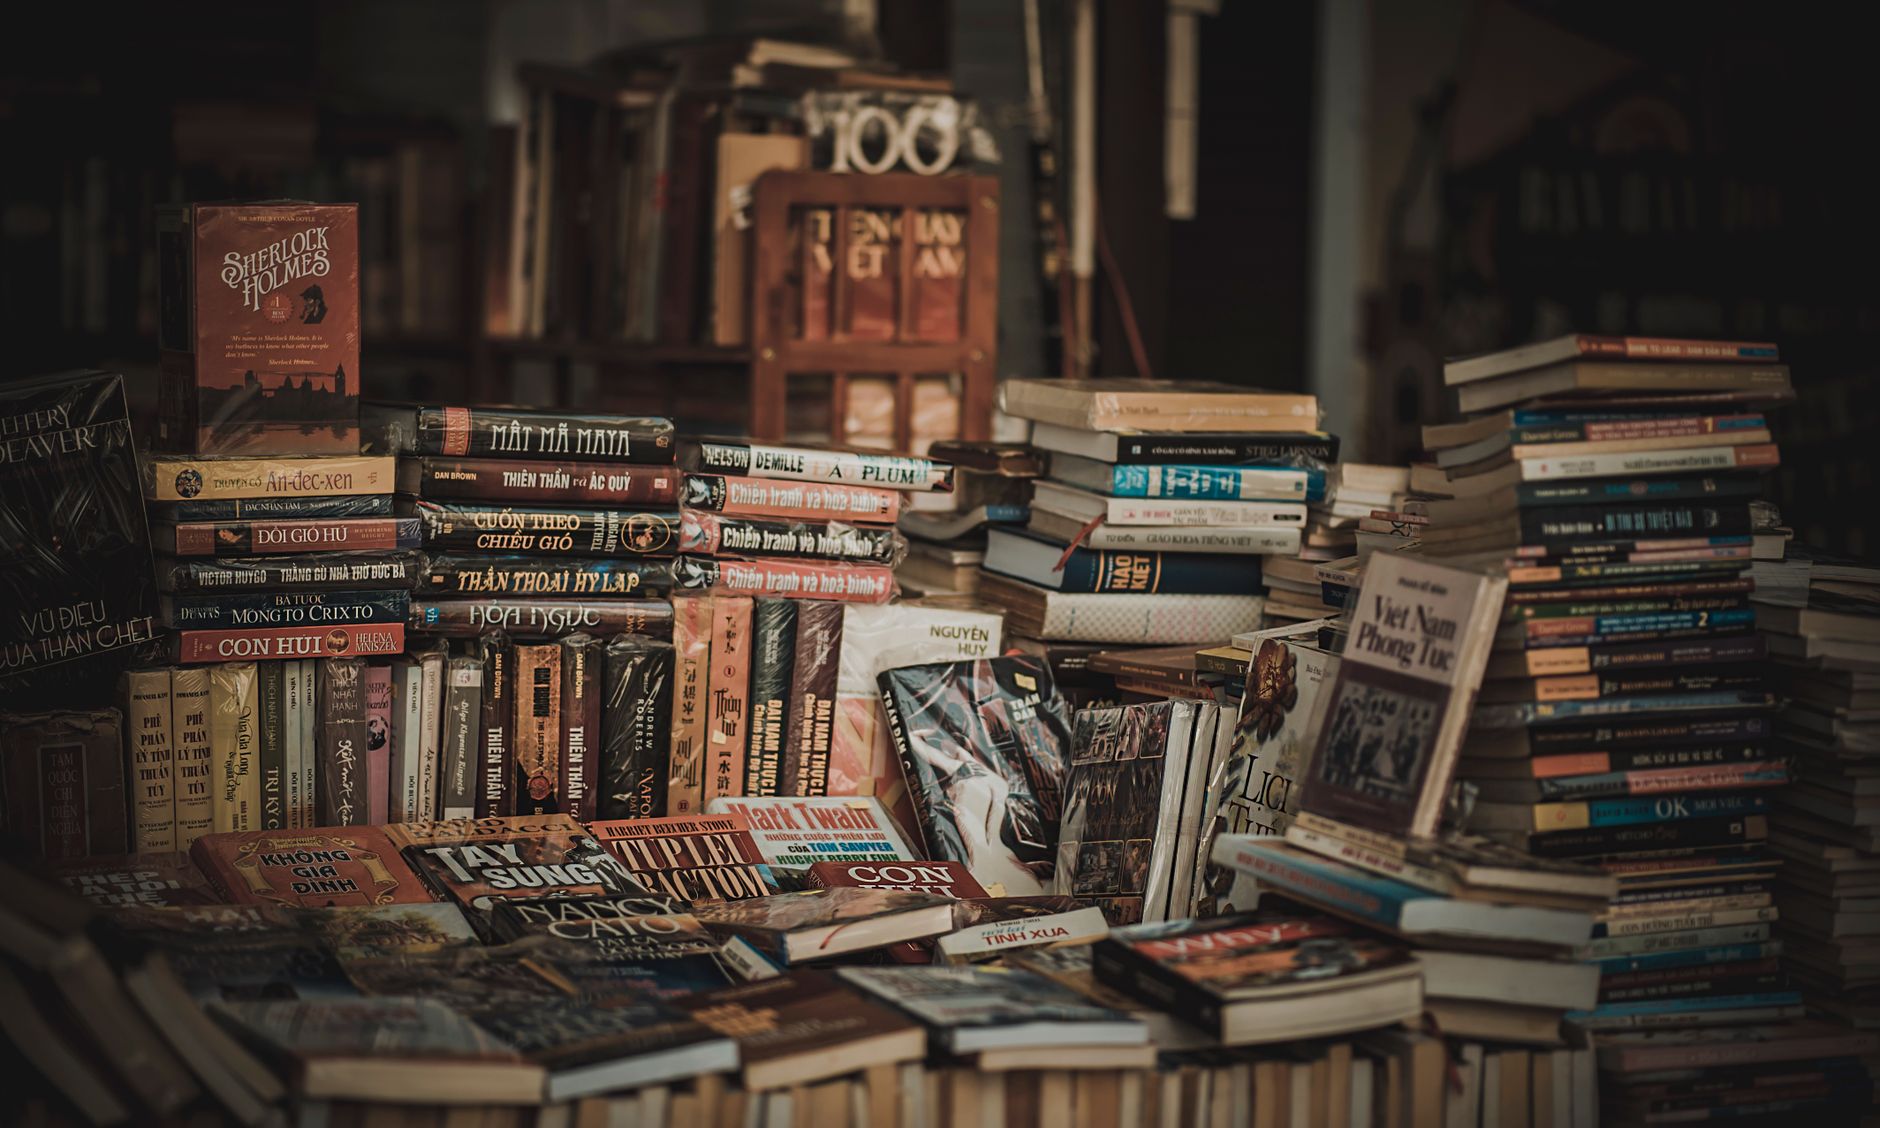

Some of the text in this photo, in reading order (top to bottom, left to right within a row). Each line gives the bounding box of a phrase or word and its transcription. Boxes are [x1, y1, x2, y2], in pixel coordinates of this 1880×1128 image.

[828, 103, 959, 176] 100
[221, 227, 330, 288] SHERLOCK
[242, 250, 330, 312] HOLMES
[0, 402, 73, 436] EFFERY
[1703, 416, 1714, 433] 1
[539, 422, 569, 453] MÃ
[576, 428, 630, 456] MAYA
[706, 447, 804, 473] NELSON DEMILLE
[434, 471, 477, 481] DAN BROWN
[503, 468, 605, 490] THIÊN THẦN và ÁC
[862, 465, 915, 484] PLUM
[731, 480, 767, 506] Chiến
[770, 485, 803, 509] tranh
[806, 489, 821, 509] và
[474, 507, 581, 531] CUỐN THEO
[258, 525, 348, 544] ĐỒI GIÓ HÚ
[476, 533, 574, 550] CHIỀU GIÓ
[723, 525, 816, 553] Chiến tranh và
[199, 569, 267, 586] VICTOR HUYGO
[280, 562, 312, 582] THẰNG
[314, 566, 326, 581] GÙ
[329, 565, 349, 580] NHÀ
[392, 561, 406, 579] BÀ
[726, 566, 764, 589] Chiến
[766, 571, 800, 592] tranh
[802, 571, 818, 593] và
[352, 603, 374, 619] TÔ
[427, 607, 438, 622] vh
[1697, 611, 1709, 628] 2
[1411, 604, 1457, 641] Nam
[218, 638, 271, 657] CON
[355, 632, 393, 643] HELENA
[355, 641, 398, 653] MNISZEK
[1355, 621, 1416, 667] Phong
[958, 643, 988, 656] HUY
[493, 653, 502, 699] DAN BROWN
[575, 653, 584, 699] DAN BROWN
[144, 713, 162, 728] PHÊ
[186, 711, 204, 726] PHÊ
[460, 701, 469, 722] Dilgo
[635, 699, 644, 752] ROBERTS
[647, 699, 657, 749] ANDREW
[141, 732, 165, 746] PHÁN
[183, 730, 206, 743] PHÁN
[458, 724, 469, 759] Khyentse
[488, 727, 505, 764] THIÊN
[569, 726, 587, 763] THIÊN
[764, 722, 782, 751] NAM
[813, 722, 830, 751] NAM
[178, 746, 191, 761] LÝ
[188, 781, 206, 795] TÚY
[266, 766, 279, 792] TRI
[147, 784, 165, 797] TÚY
[726, 802, 879, 831] Mark Twain
[1654, 797, 1691, 819] OK
[605, 819, 737, 837] HARRIET BEECHER STOWE
[258, 849, 351, 867] KHÔNG
[788, 842, 894, 853] CỦA TOM SAWYER
[291, 865, 337, 879] GIA
[424, 844, 520, 882] TAY
[848, 866, 955, 884] CON
[291, 877, 359, 895] ĐÌNH
[514, 897, 680, 923] NANCY
[548, 918, 681, 940] CATO
